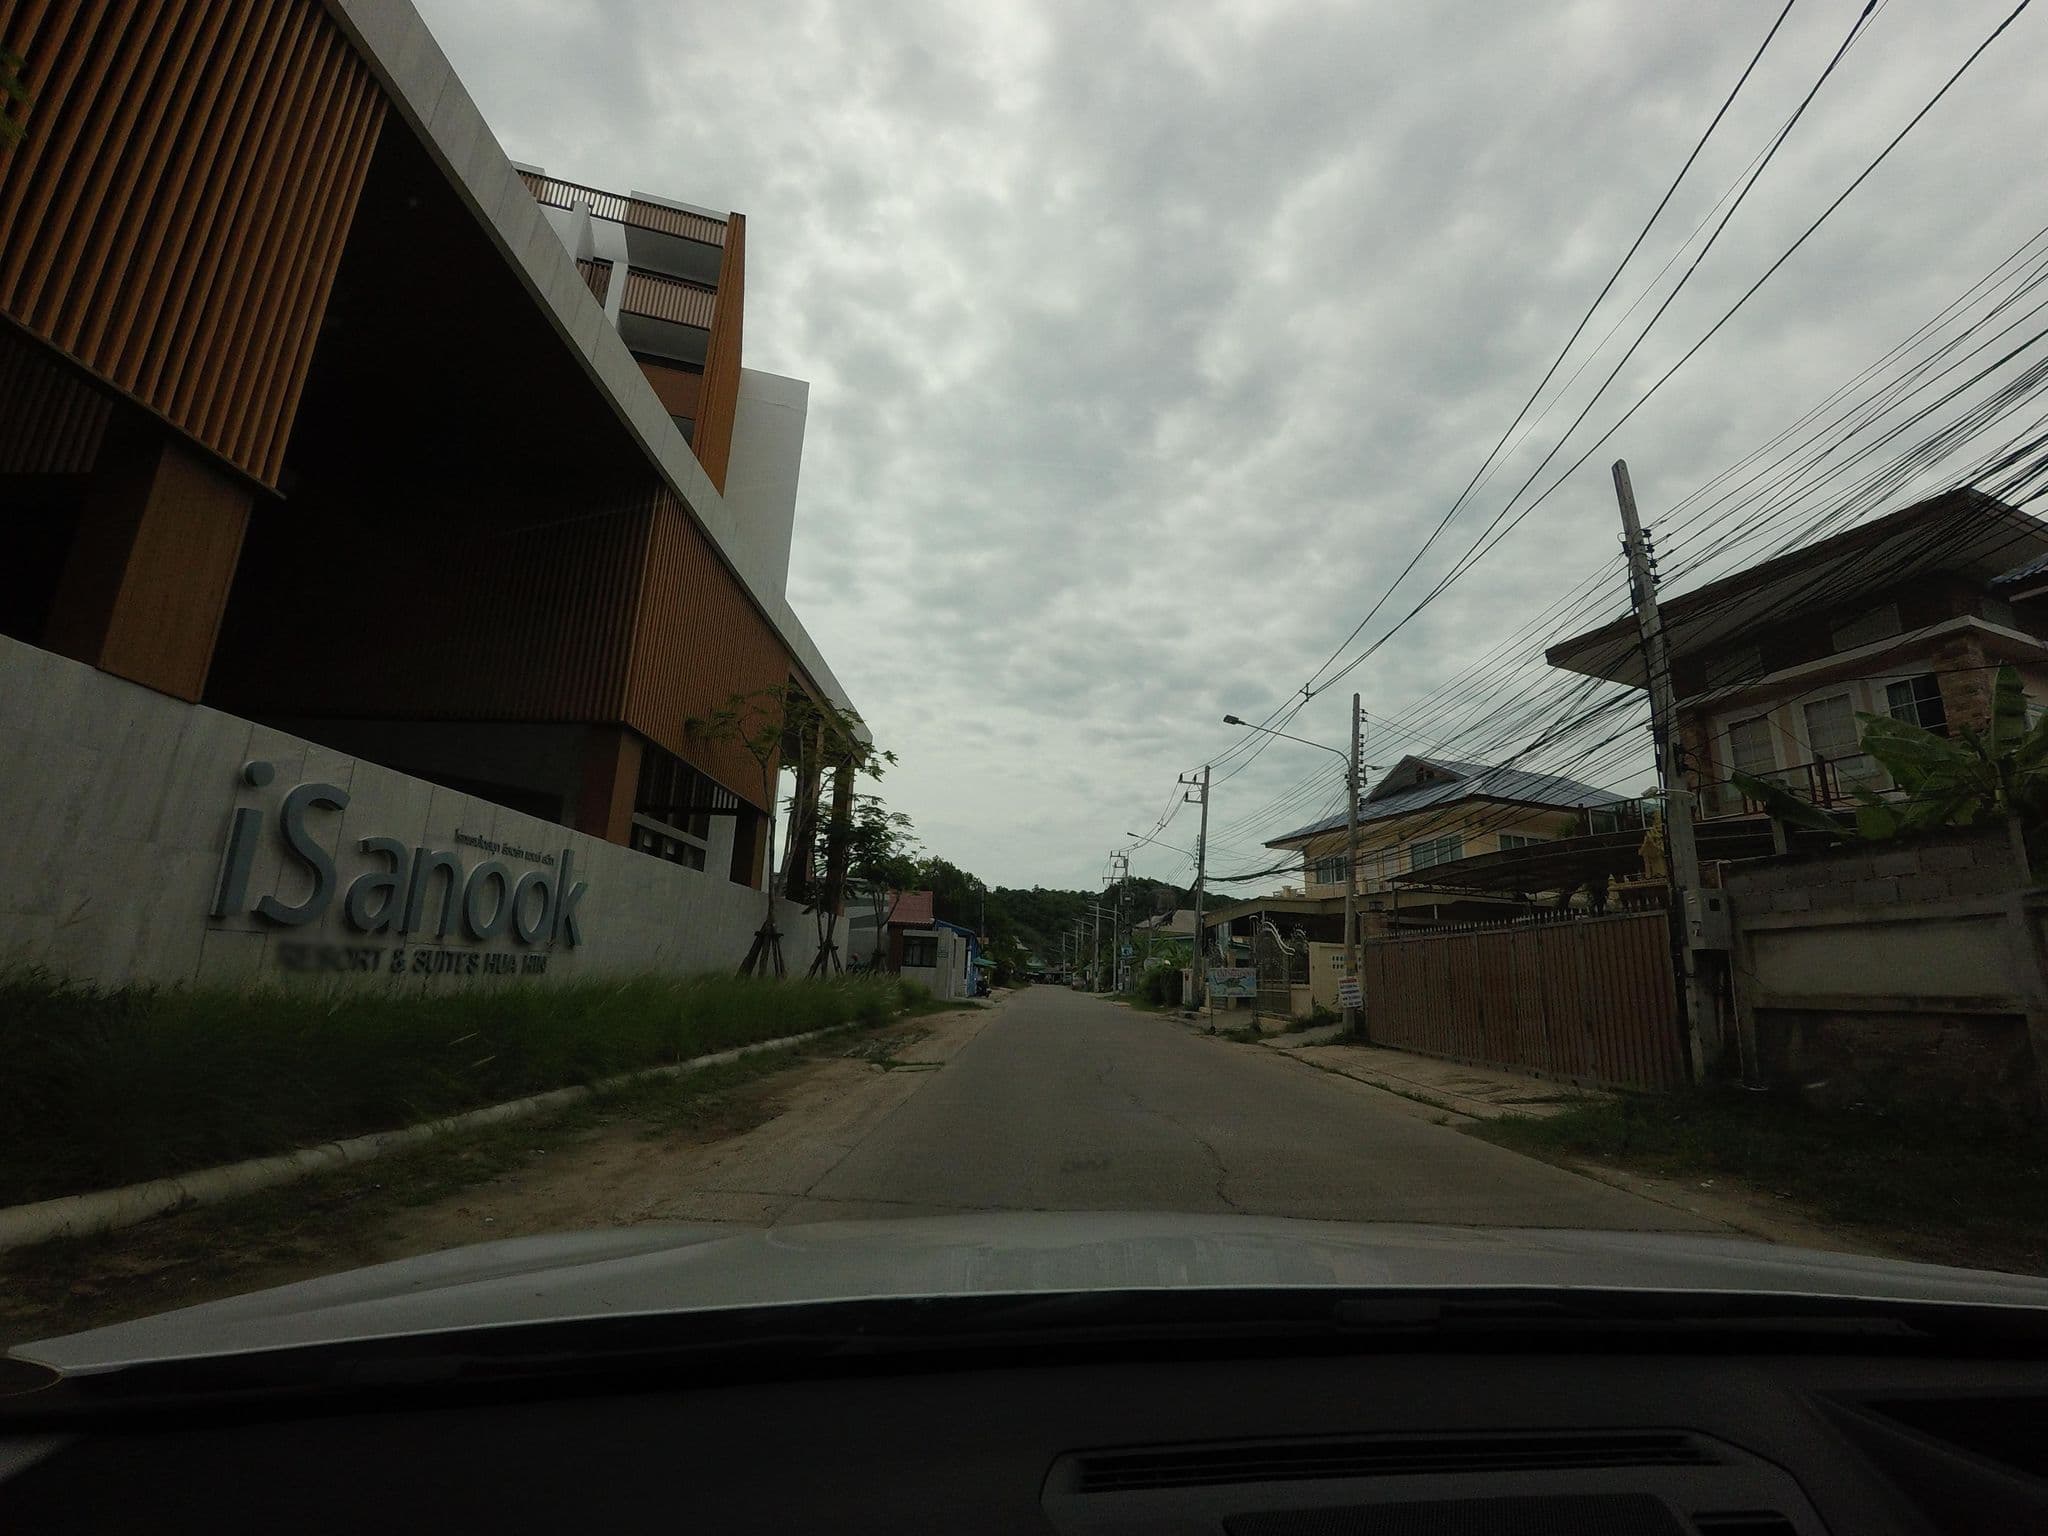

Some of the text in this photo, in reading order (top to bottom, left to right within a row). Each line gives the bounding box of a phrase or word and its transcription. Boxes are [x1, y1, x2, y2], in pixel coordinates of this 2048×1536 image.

[210, 760, 588, 946] iSanook
[390, 949, 406, 973] &
[412, 950, 480, 975] SUITES
